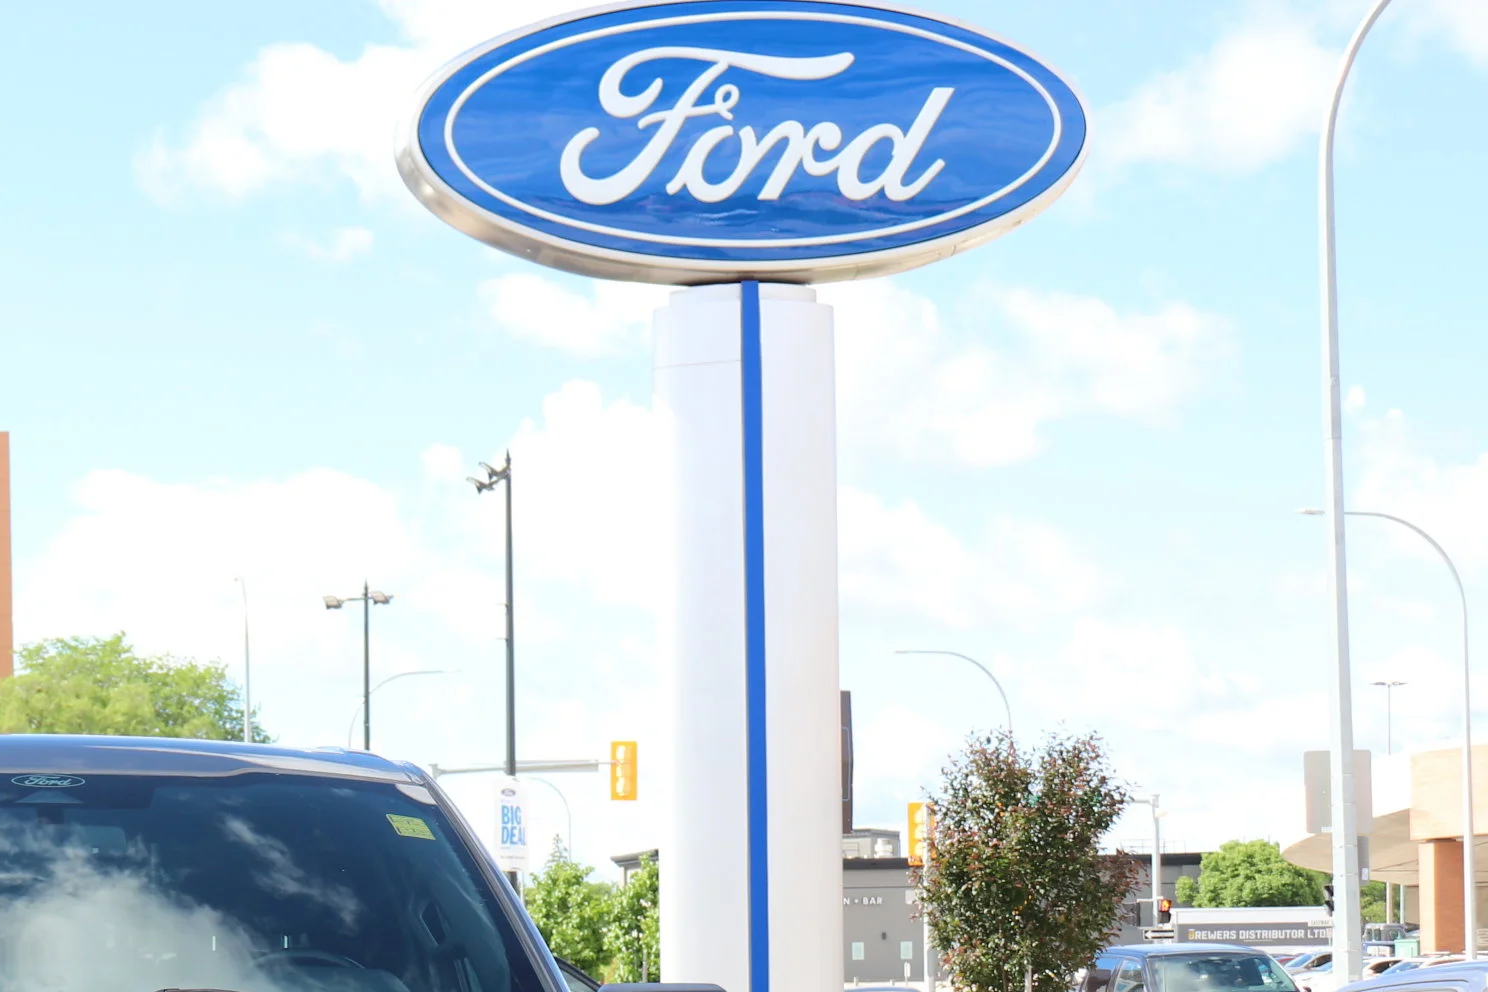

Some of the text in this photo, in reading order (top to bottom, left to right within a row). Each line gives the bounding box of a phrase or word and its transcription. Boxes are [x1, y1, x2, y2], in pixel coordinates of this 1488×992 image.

[559, 45, 956, 205] Ford
[500, 804, 522, 825] BIG
[500, 825, 527, 846] DEAL
[862, 896, 883, 905] BAR
[1239, 929, 1305, 940] DISTRIBUTOR
